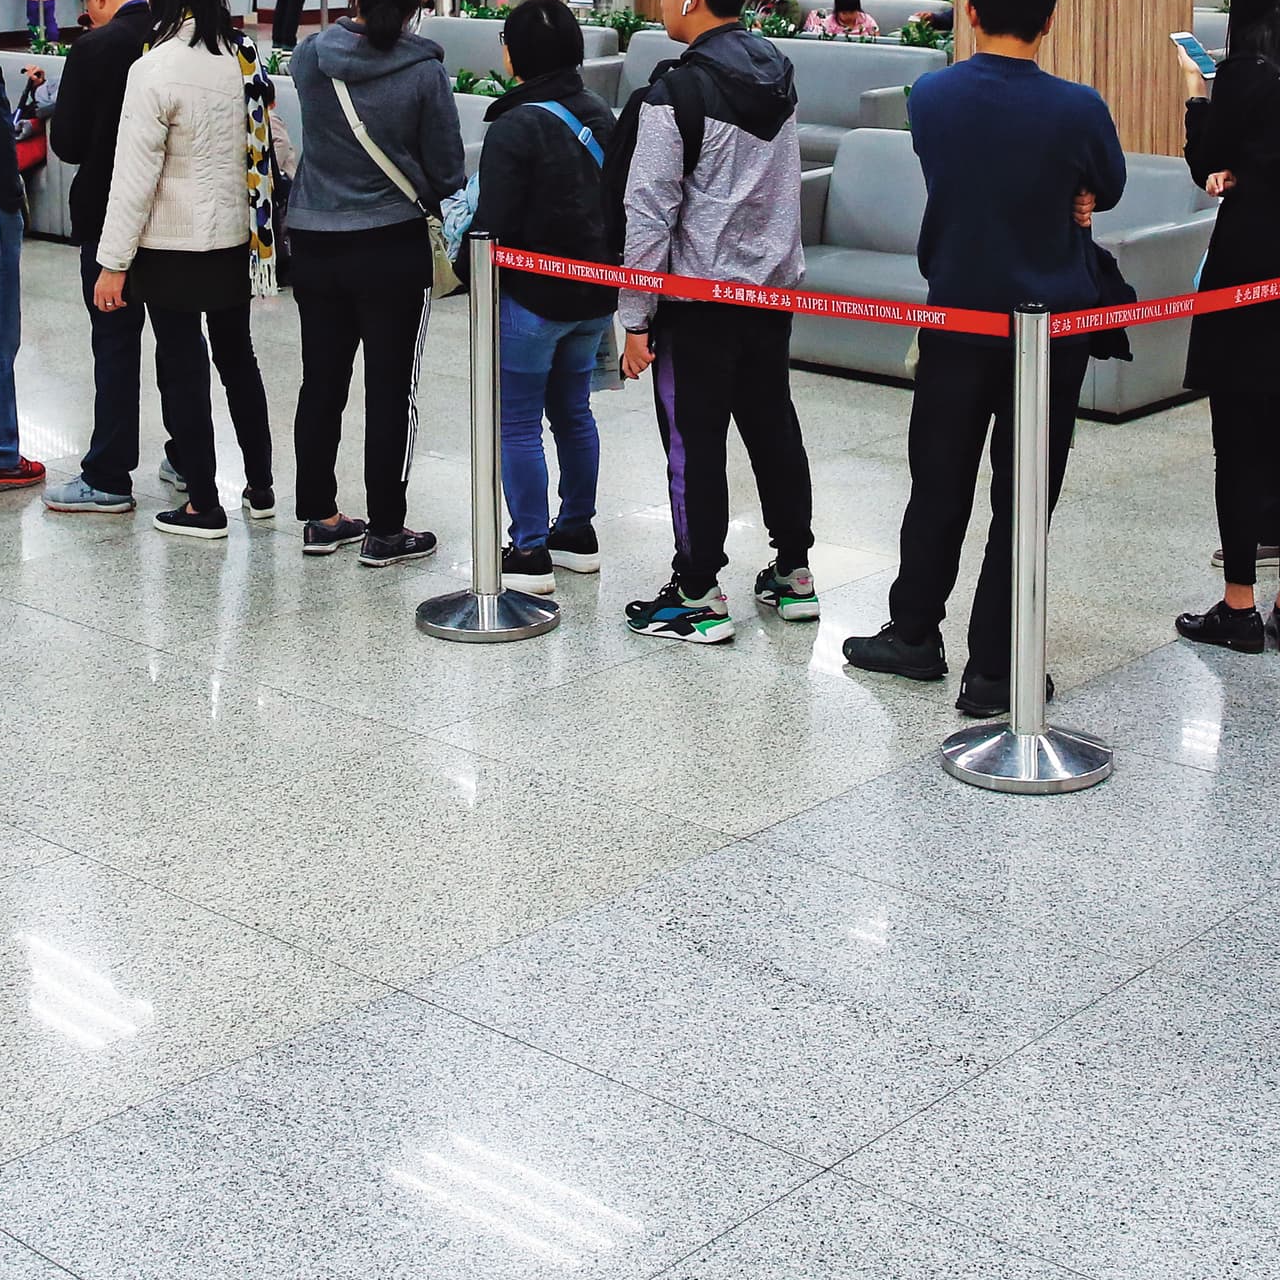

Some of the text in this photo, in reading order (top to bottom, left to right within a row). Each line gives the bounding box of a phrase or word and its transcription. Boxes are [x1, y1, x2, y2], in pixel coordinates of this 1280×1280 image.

[495, 250, 664, 289] 際航空站 TAIPEI INTERNATIONAL AIRPORT
[712, 284, 947, 325] 臺北國際航空站 TAIPEI INTERNATIONAL AIRPORT
[1049, 298, 1194, 335] 空站 TAIPEI INTERNATIONAL AIRPORT
